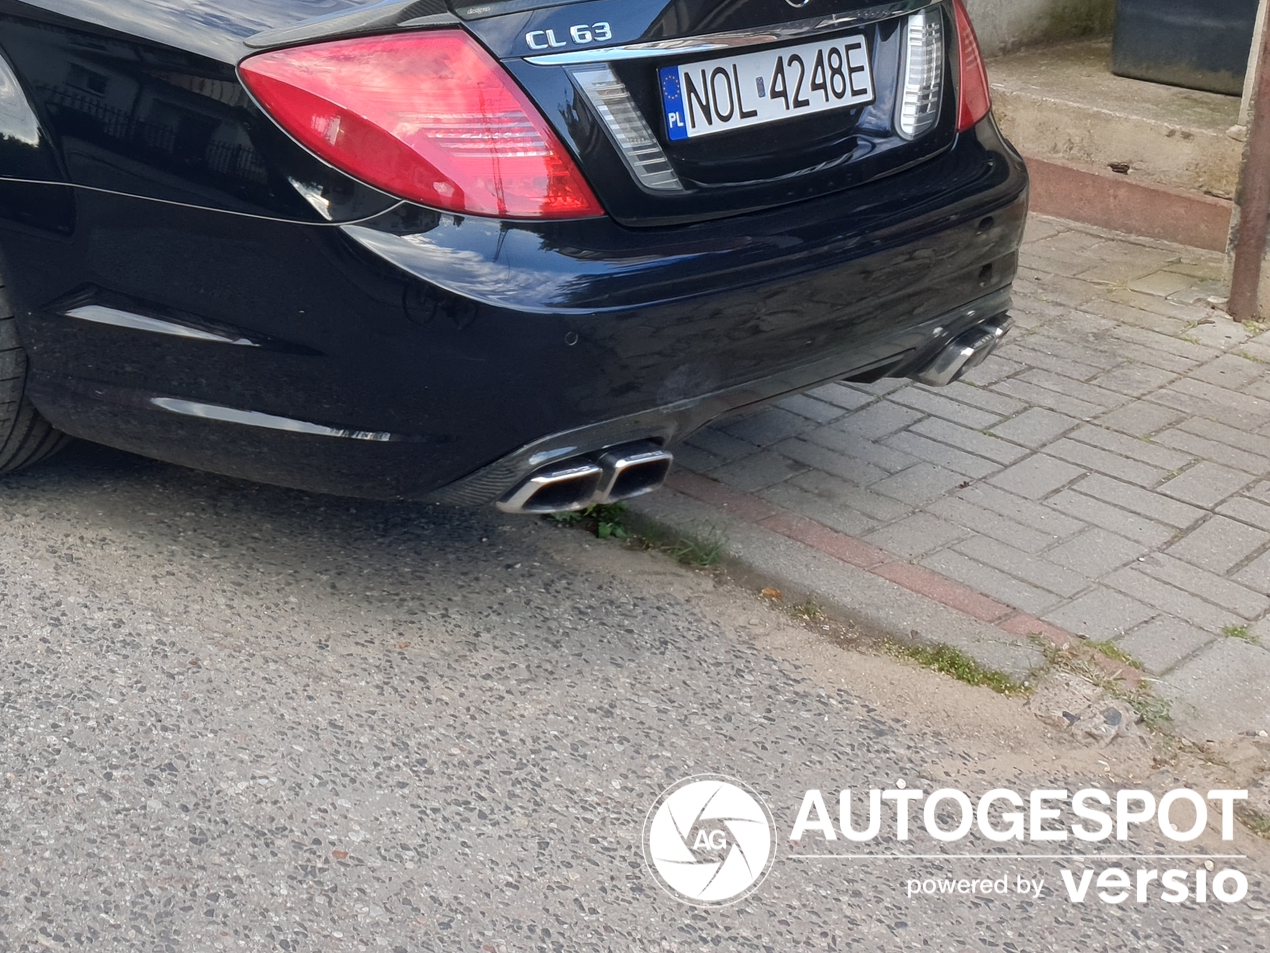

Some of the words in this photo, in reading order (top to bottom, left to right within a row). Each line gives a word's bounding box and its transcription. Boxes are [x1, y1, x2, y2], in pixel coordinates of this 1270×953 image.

[525, 28, 567, 50] CL
[569, 21, 613, 44] 63
[684, 63, 758, 129] NOL
[769, 42, 868, 111] 4248E
[668, 111, 685, 129] PL
